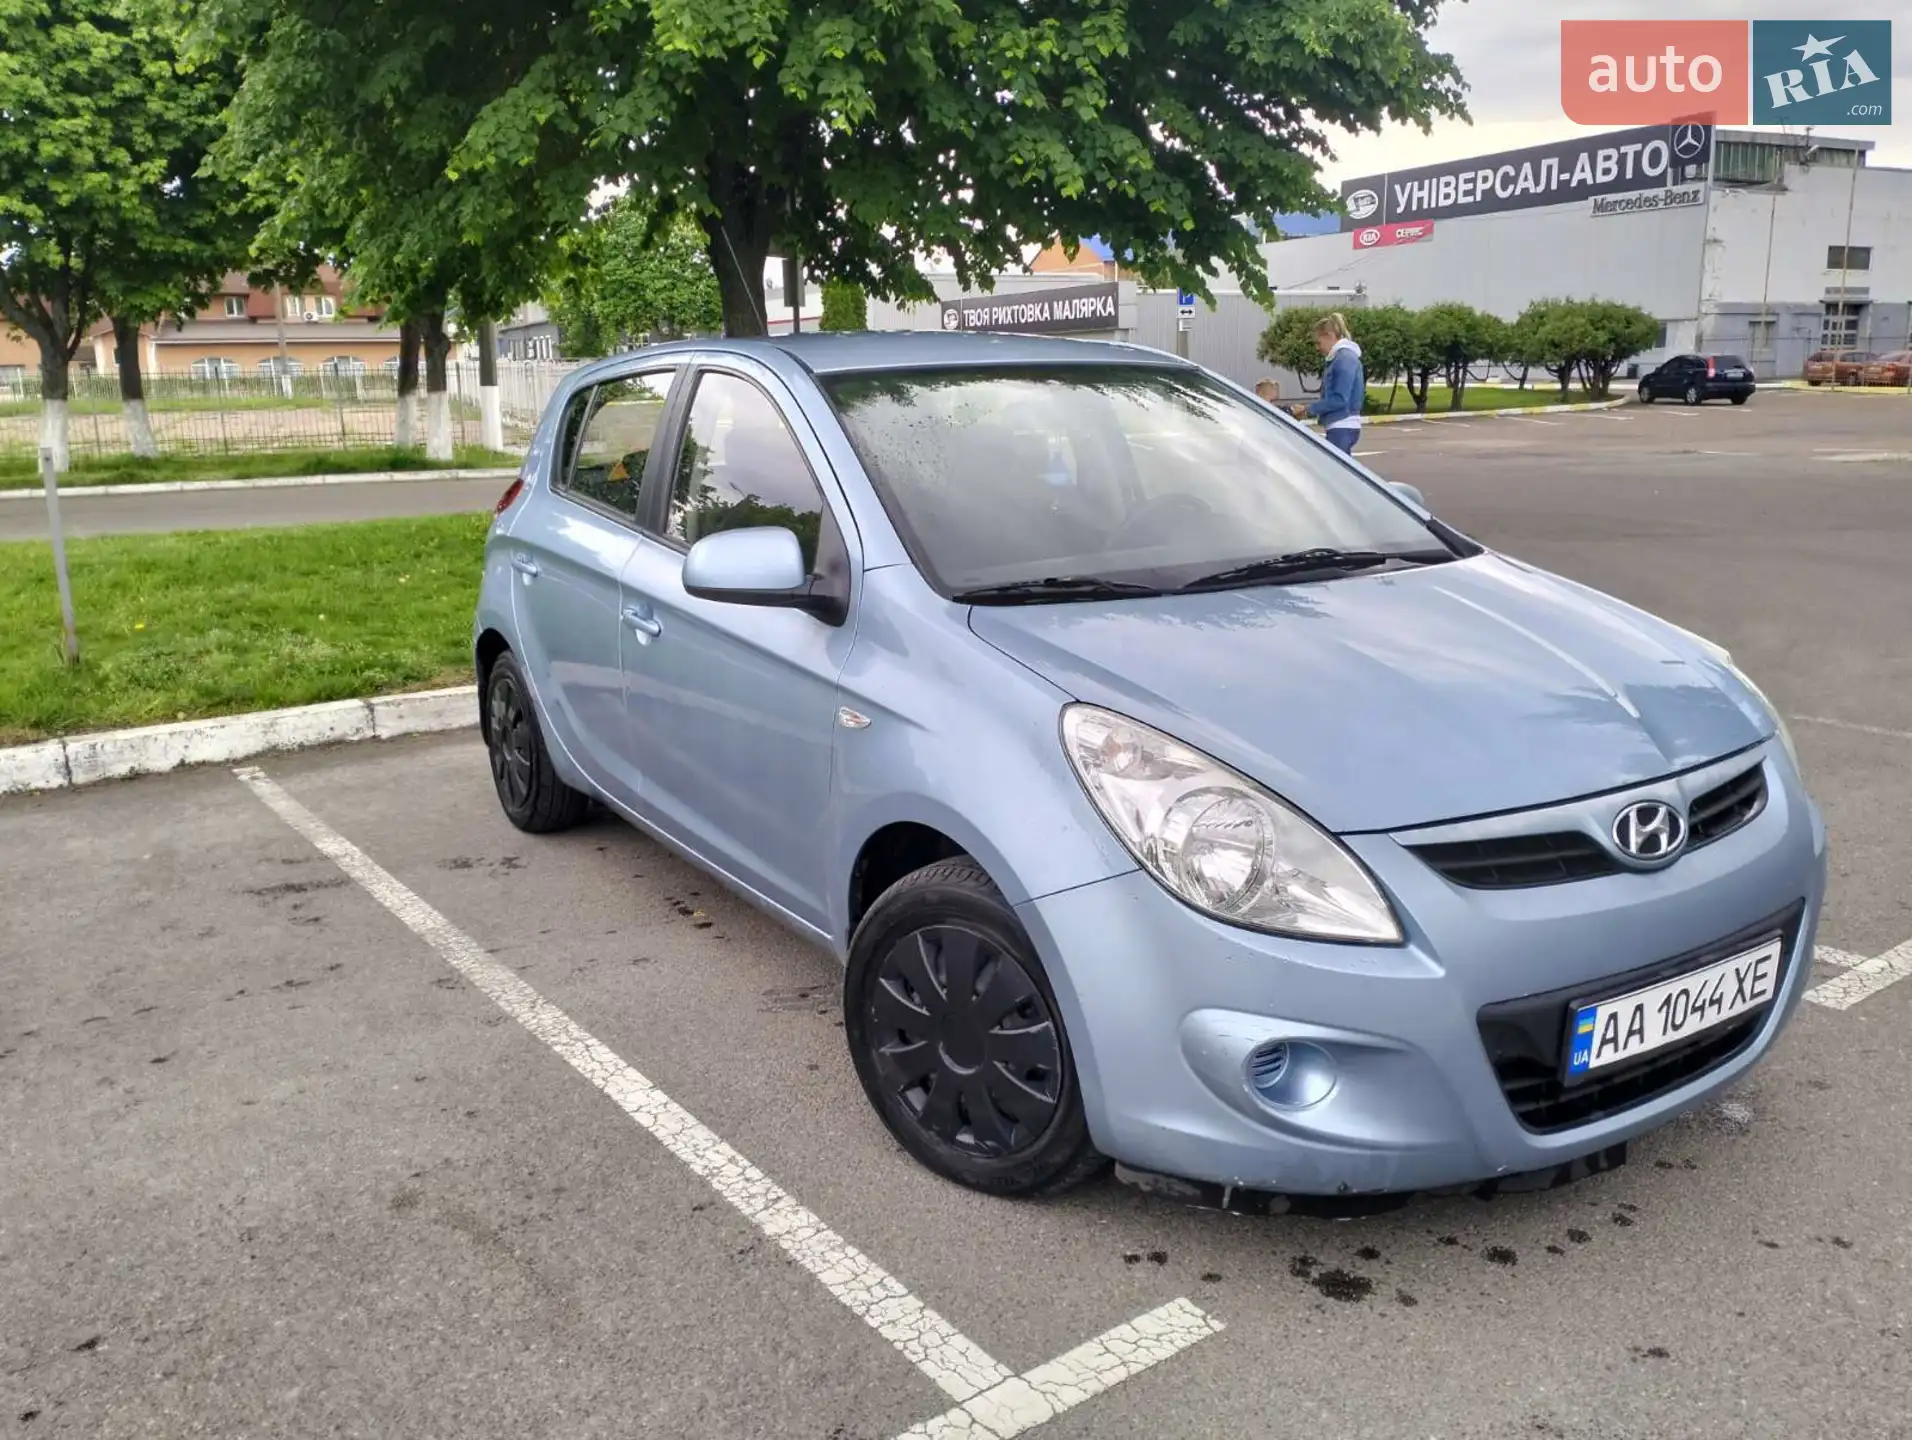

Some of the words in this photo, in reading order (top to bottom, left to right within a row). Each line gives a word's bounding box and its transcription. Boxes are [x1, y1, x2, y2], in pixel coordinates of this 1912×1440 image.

[1394, 139, 1670, 214] УНІВЕРСАЛ-АВТО
[1592, 189, 1701, 214] Mercedes-Benz
[963, 307, 990, 327] ТВОЯ
[992, 302, 1051, 326] РИХТОВКА
[1053, 295, 1116, 321] МАЛЯРКА
[1595, 1002, 1645, 1060] AA
[1657, 972, 1726, 1037] 1044
[1728, 954, 1773, 1011] XE
[1573, 1049, 1589, 1066] UA
